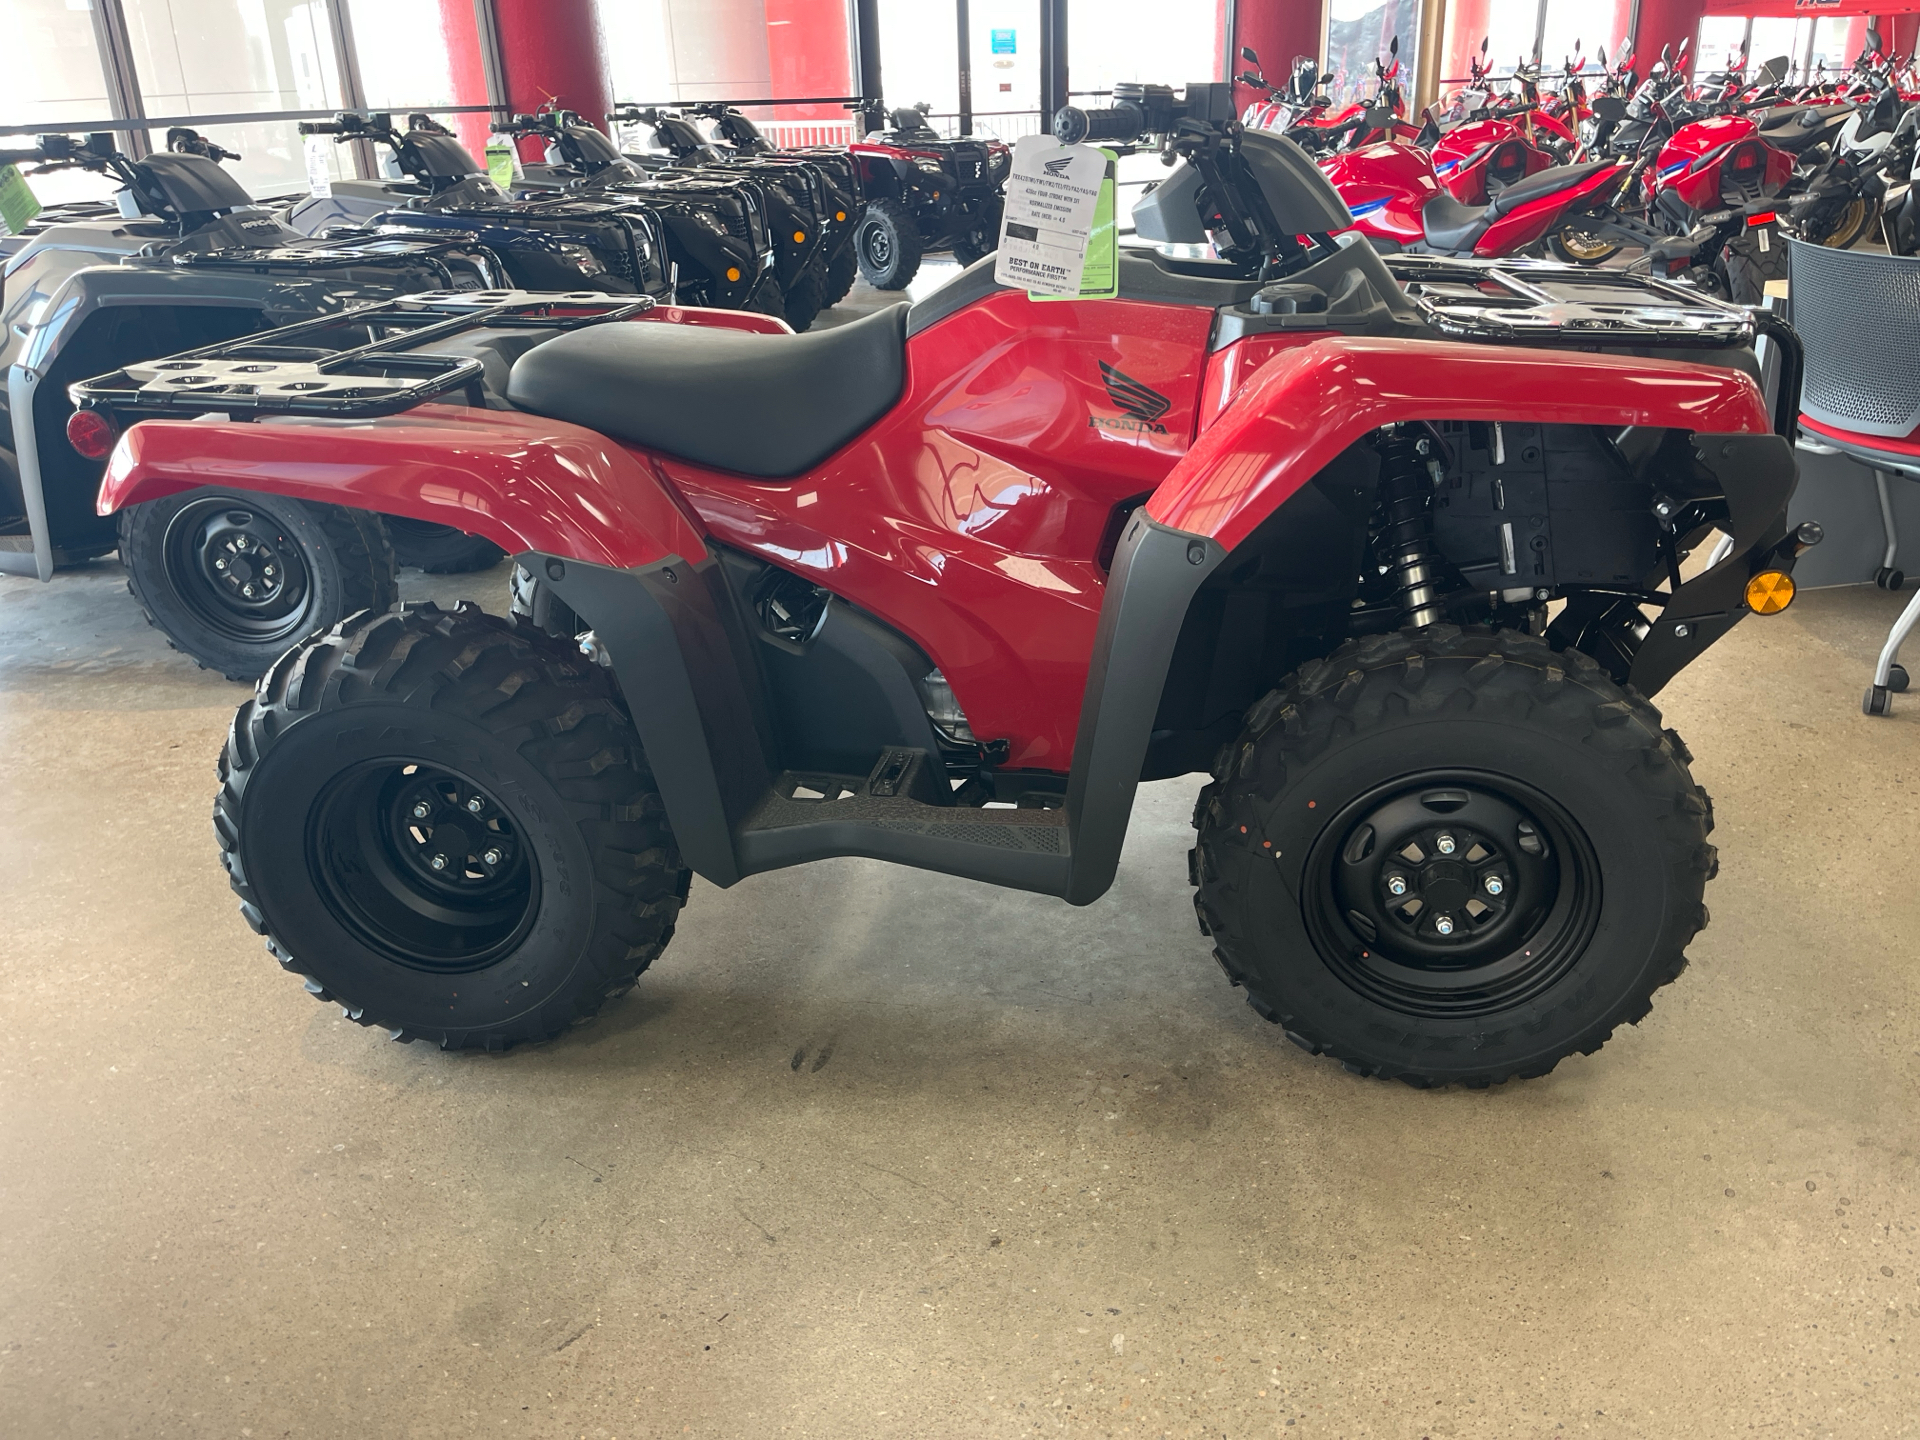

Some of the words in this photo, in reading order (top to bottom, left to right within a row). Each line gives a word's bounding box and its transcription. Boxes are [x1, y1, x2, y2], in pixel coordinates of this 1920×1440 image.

[1043, 171, 1070, 180] HONDA
[1029, 200, 1053, 210] NORMALIZED
[1053, 205, 1072, 213] EMISSION
[1008, 257, 1028, 267] BEST
[1029, 261, 1040, 270] ON
[1009, 266, 1046, 278] PERFORMANCE
[1088, 416, 1170, 436] HONDA
